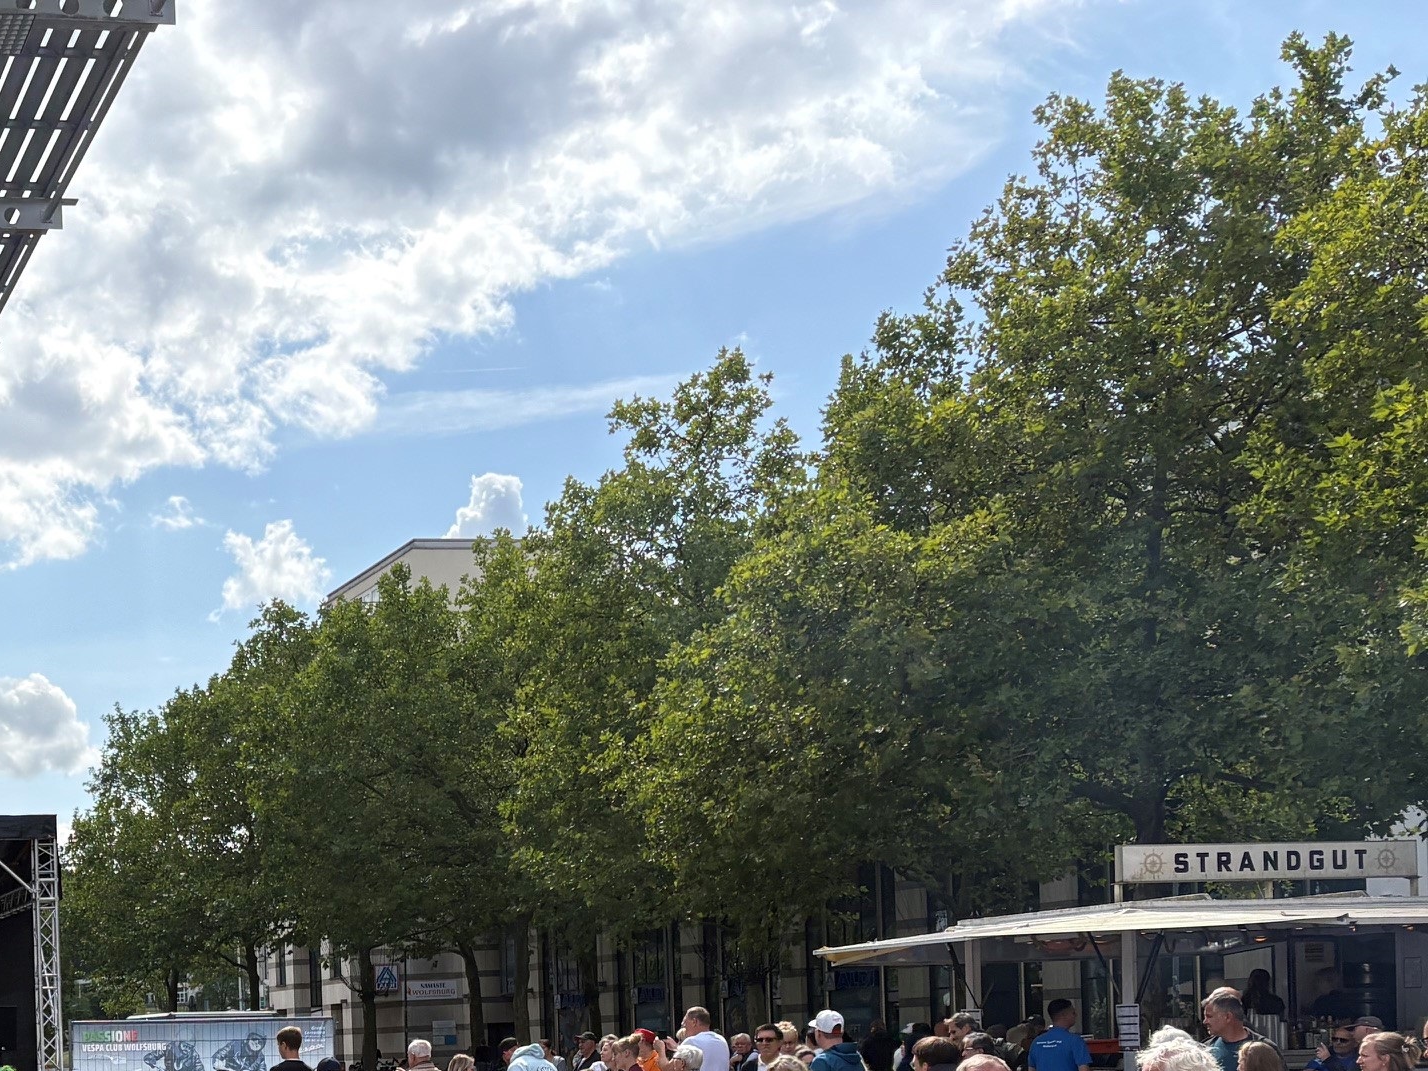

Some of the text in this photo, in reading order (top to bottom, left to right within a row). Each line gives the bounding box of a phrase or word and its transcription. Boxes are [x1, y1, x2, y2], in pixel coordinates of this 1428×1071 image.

[1174, 849, 1368, 874] STRANDGUT
[412, 988, 456, 996] WOLFSBURG
[83, 1030, 139, 1043] PASSIONE
[82, 1042, 167, 1052] VESPA CLUB WOLFSBURG
